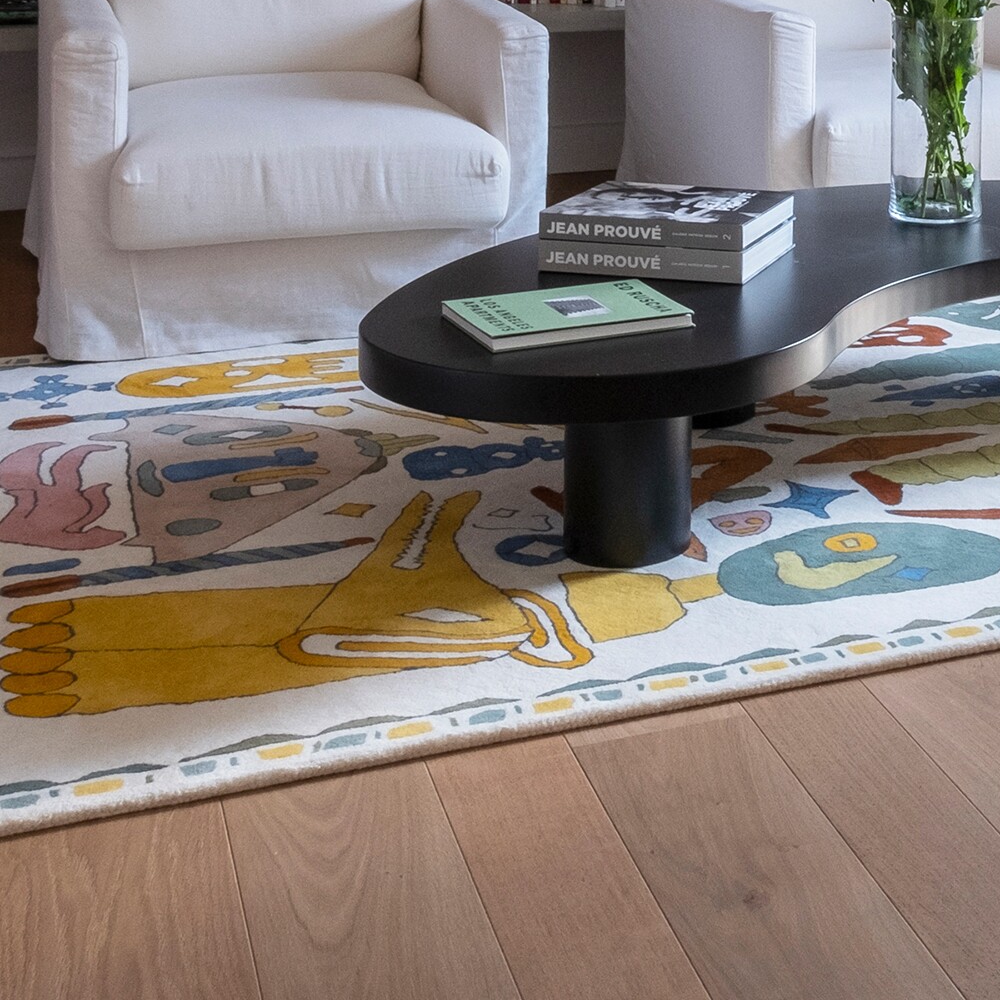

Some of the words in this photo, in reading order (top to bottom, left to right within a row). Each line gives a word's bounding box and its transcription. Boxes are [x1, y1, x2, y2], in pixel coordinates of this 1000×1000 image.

[547, 221, 589, 236] JEAN
[594, 225, 662, 240] PROUVÉ
[546, 251, 589, 265] JEAN
[594, 255, 661, 270] PROUVÉ
[614, 282, 633, 294] ED
[629, 291, 672, 313] RUSCHA
[462, 301, 515, 332] APARTMENTS
[479, 298, 501, 310] LOS
[495, 308, 533, 330] ANGELES
